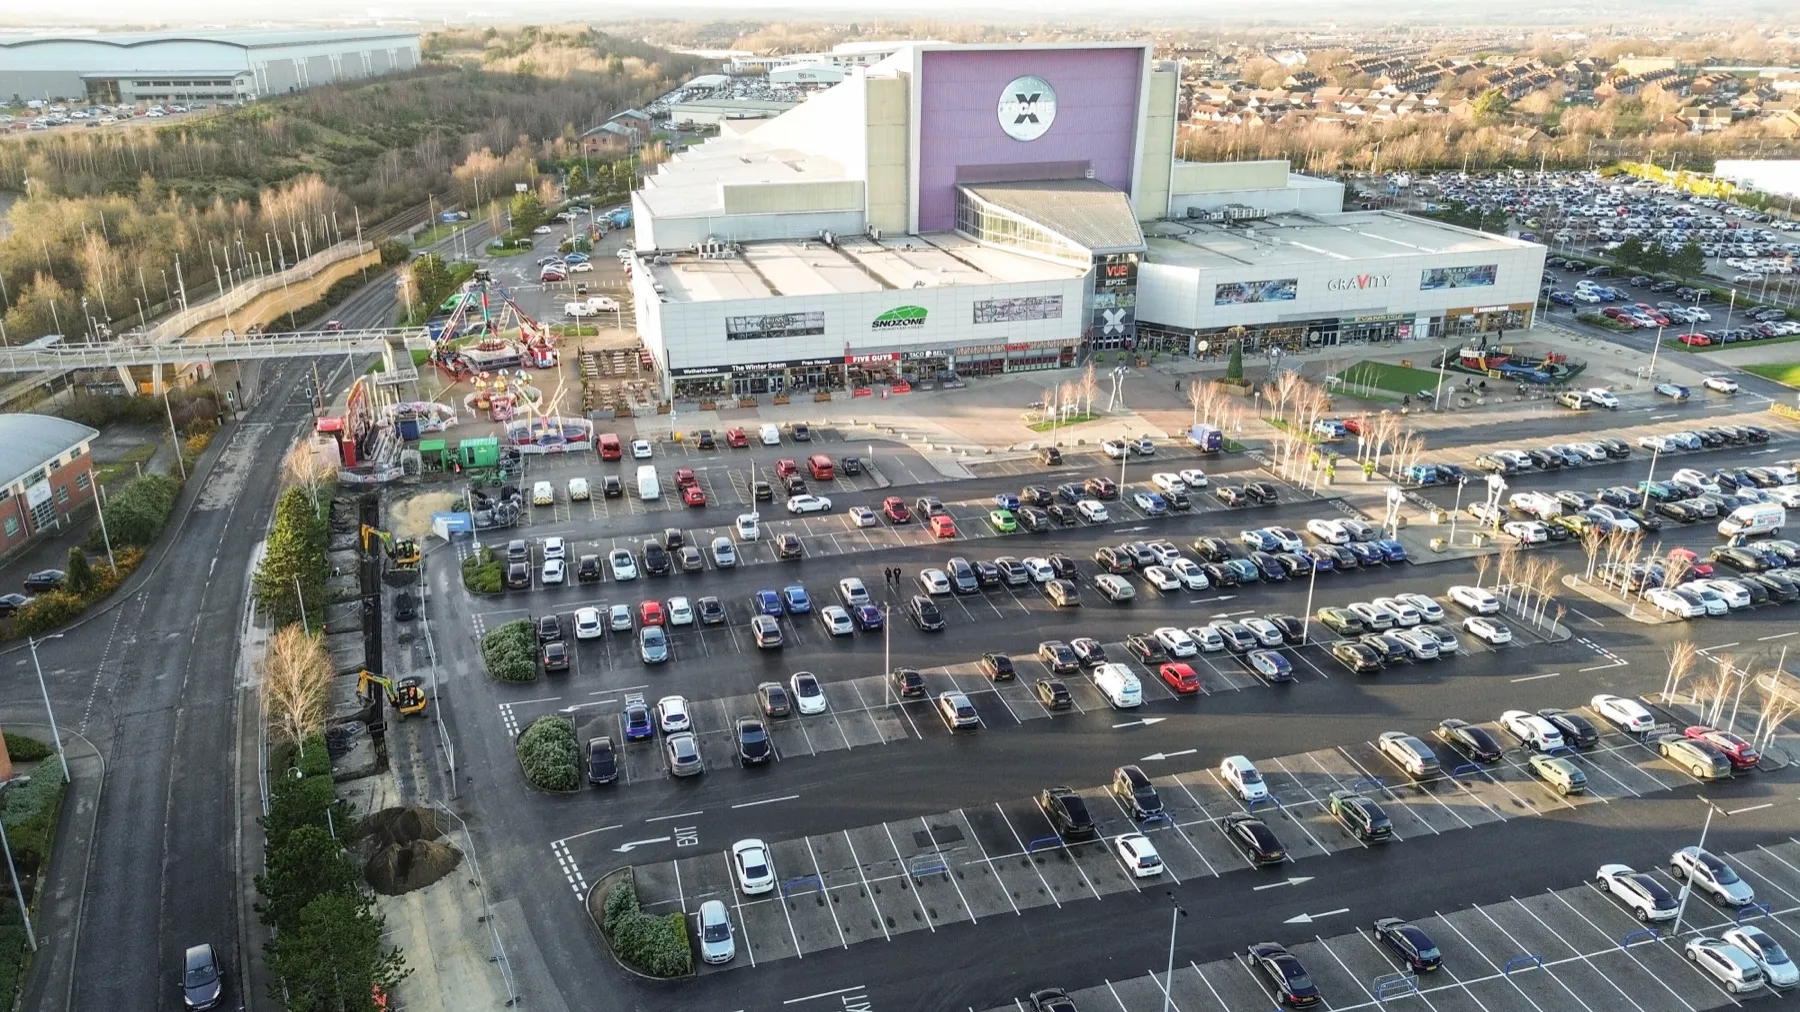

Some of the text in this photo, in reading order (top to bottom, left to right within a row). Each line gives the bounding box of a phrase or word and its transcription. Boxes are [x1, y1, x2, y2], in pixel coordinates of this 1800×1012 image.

[1105, 278, 1127, 286] EPIC
[1328, 272, 1392, 291] GRAVITY
[872, 318, 926, 328] SNOZONE
[853, 354, 893, 363] FIVE GUYS
[745, 363, 767, 371] Winter
[768, 362, 787, 370] Seam
[674, 826, 698, 847] EXIT
